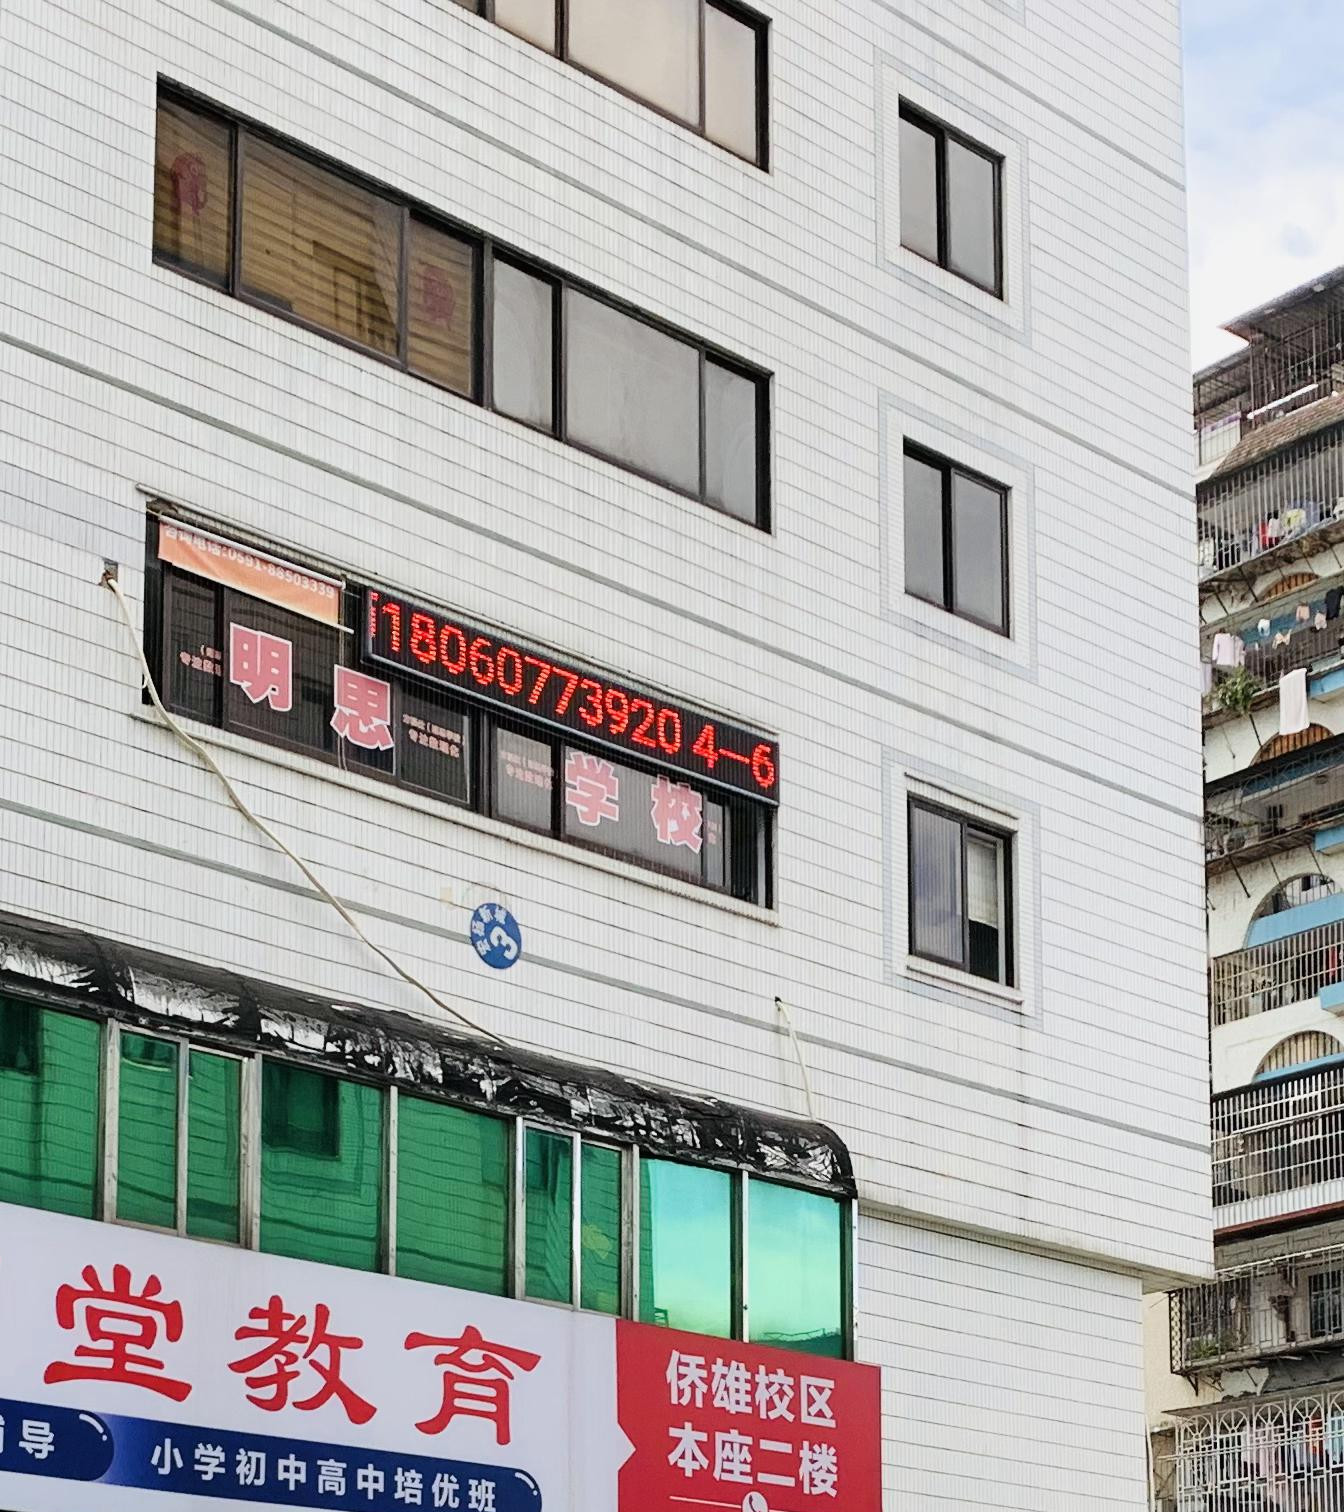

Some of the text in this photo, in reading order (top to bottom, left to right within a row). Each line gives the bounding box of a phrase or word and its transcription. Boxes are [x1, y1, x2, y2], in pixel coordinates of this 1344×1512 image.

[665, 1349, 837, 1429] 侨雄校区
[667, 1421, 839, 1498] 本座二楼
